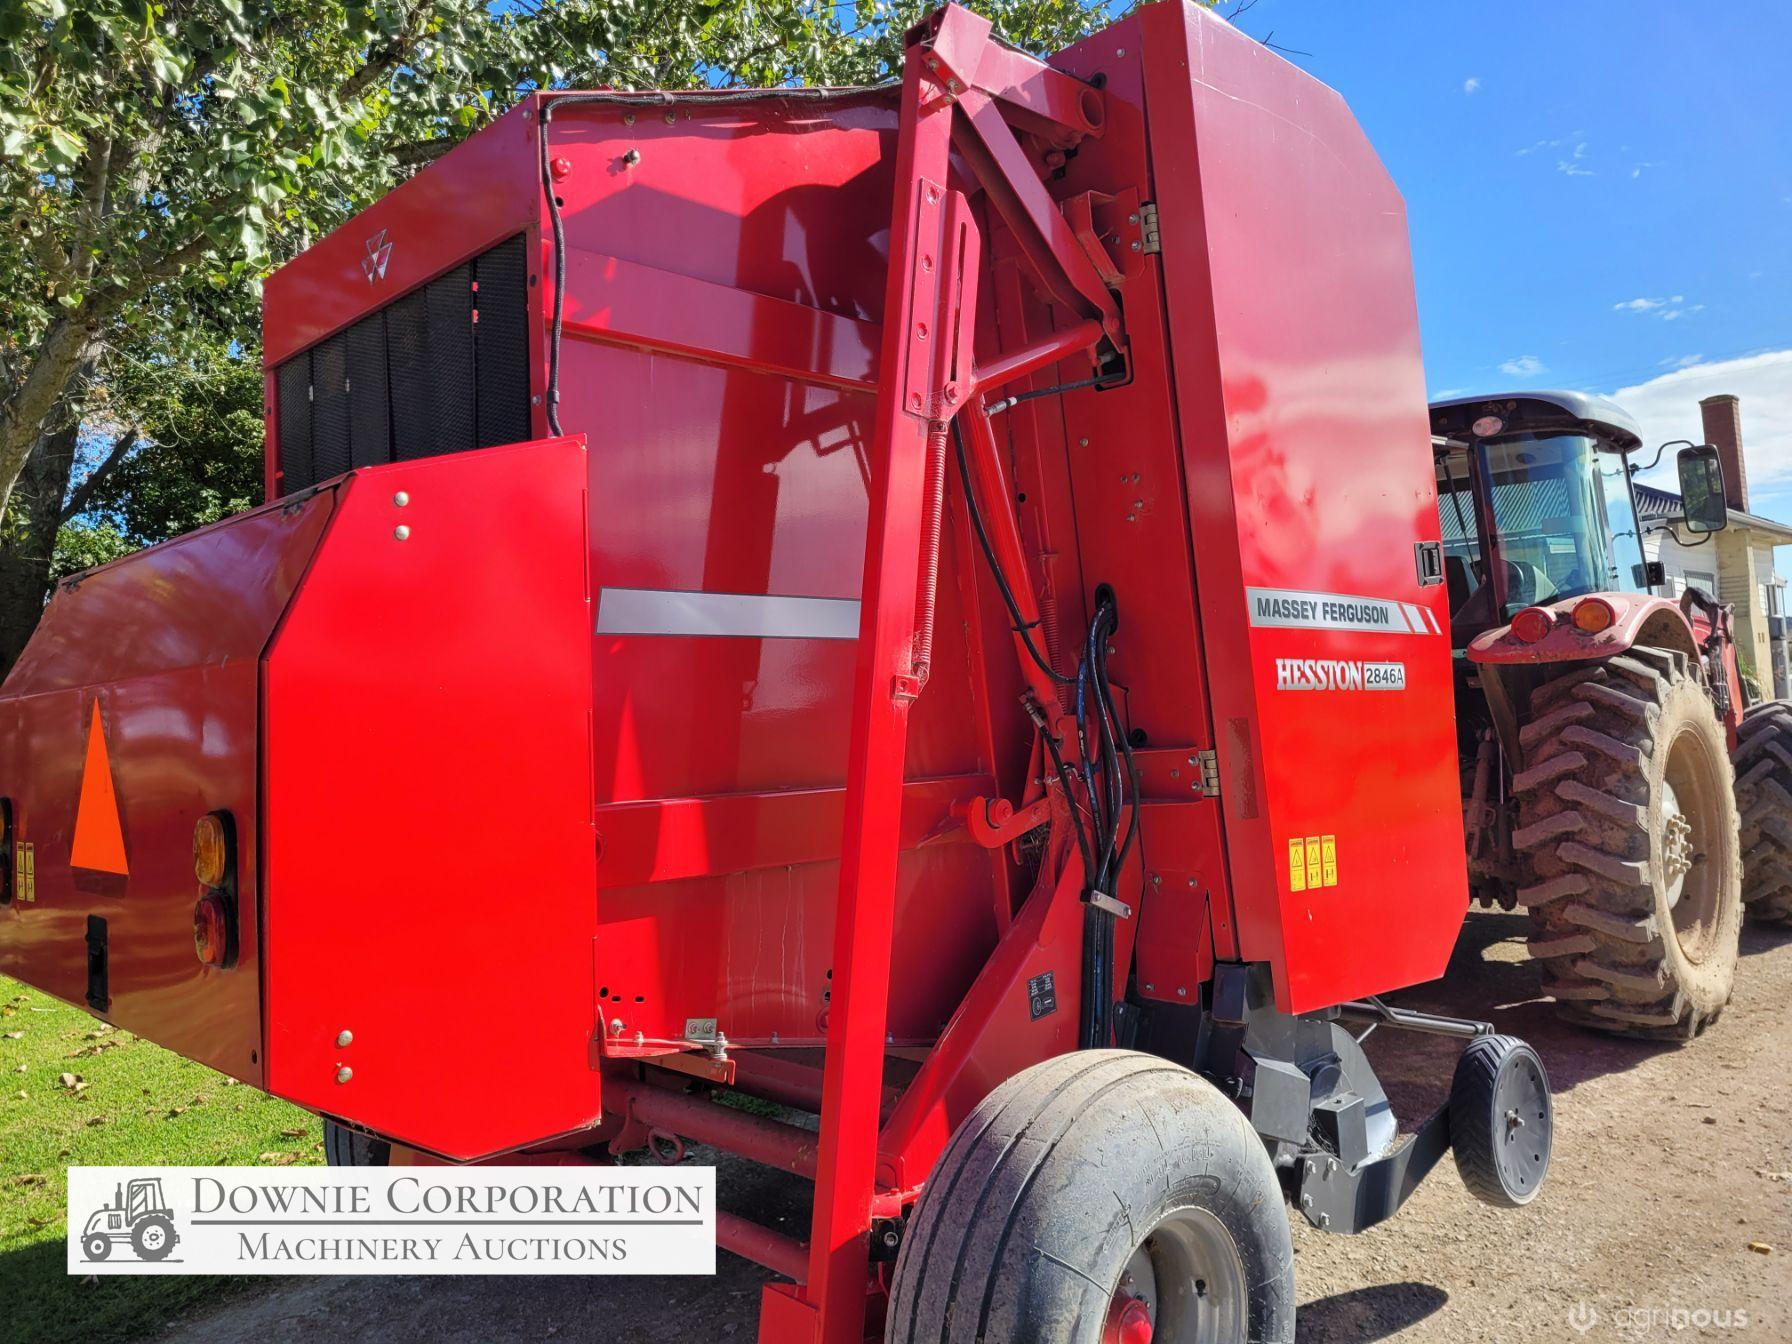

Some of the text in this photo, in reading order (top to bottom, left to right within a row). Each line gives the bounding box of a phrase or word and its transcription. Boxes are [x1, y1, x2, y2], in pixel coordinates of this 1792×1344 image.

[1257, 597, 1389, 625] MASSEY FERGUSON
[1275, 657, 1404, 691] HESSTON 2846A
